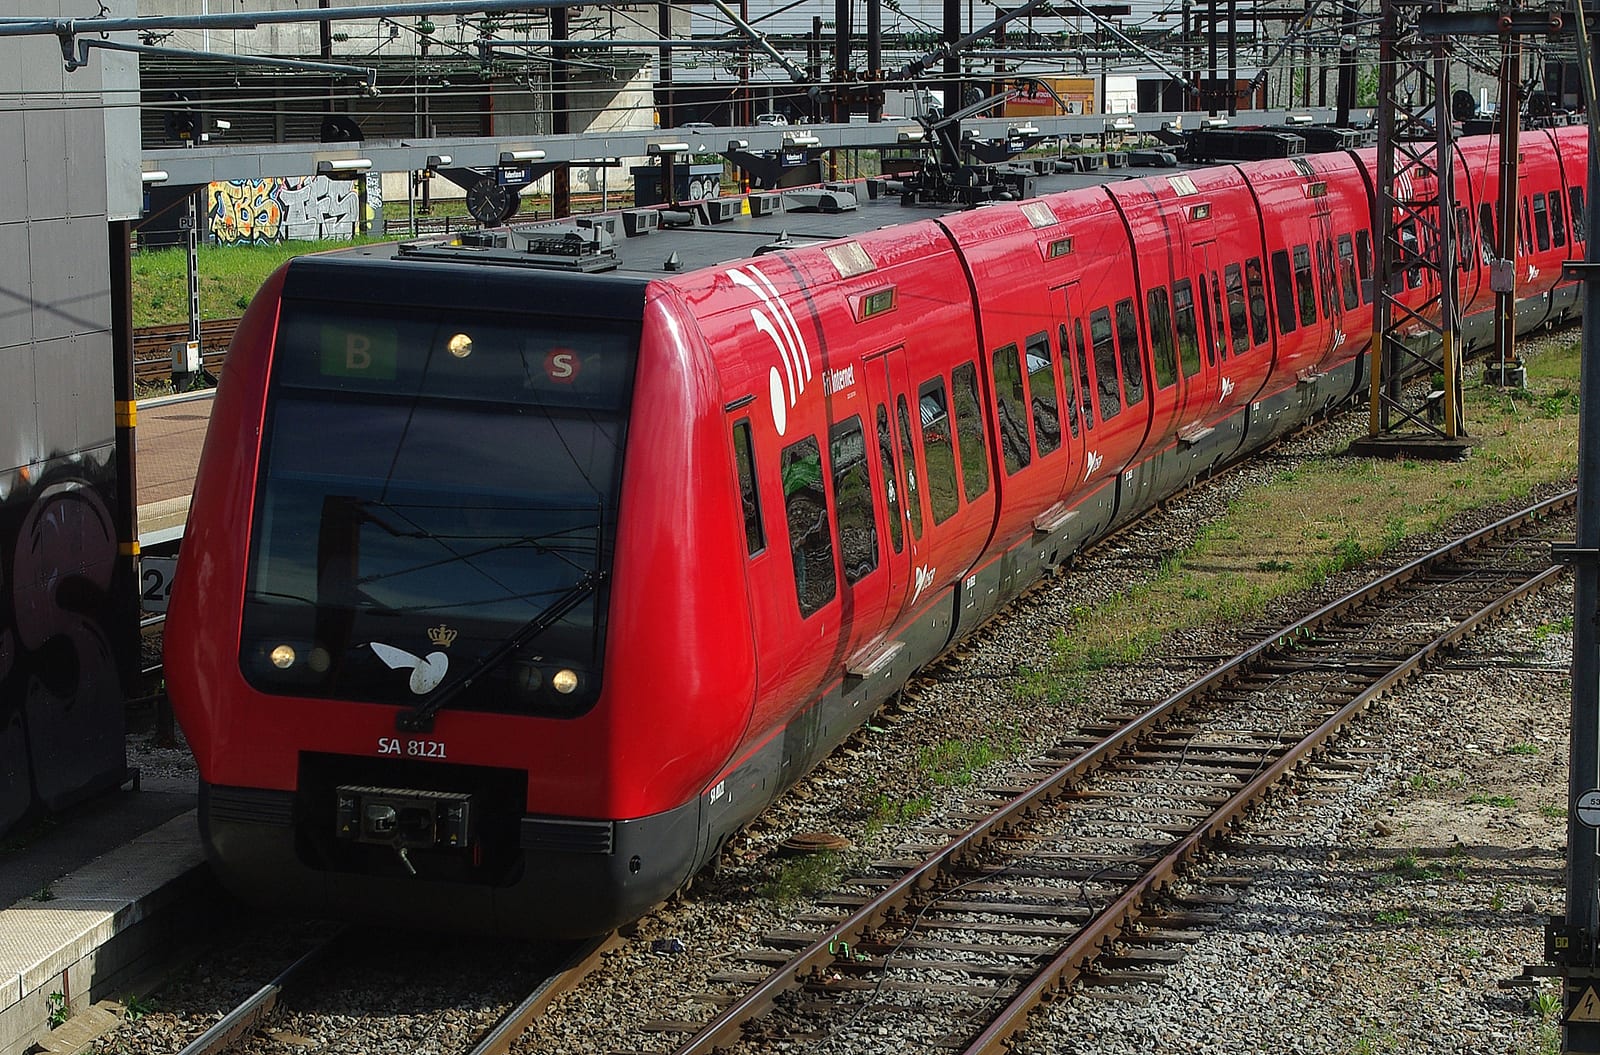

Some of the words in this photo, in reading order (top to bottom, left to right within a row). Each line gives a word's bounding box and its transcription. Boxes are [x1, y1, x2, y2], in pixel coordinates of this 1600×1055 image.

[346, 334, 371, 369] B
[552, 355, 573, 377] S
[378, 738, 401, 754] SA
[407, 740, 447, 758] 8121
